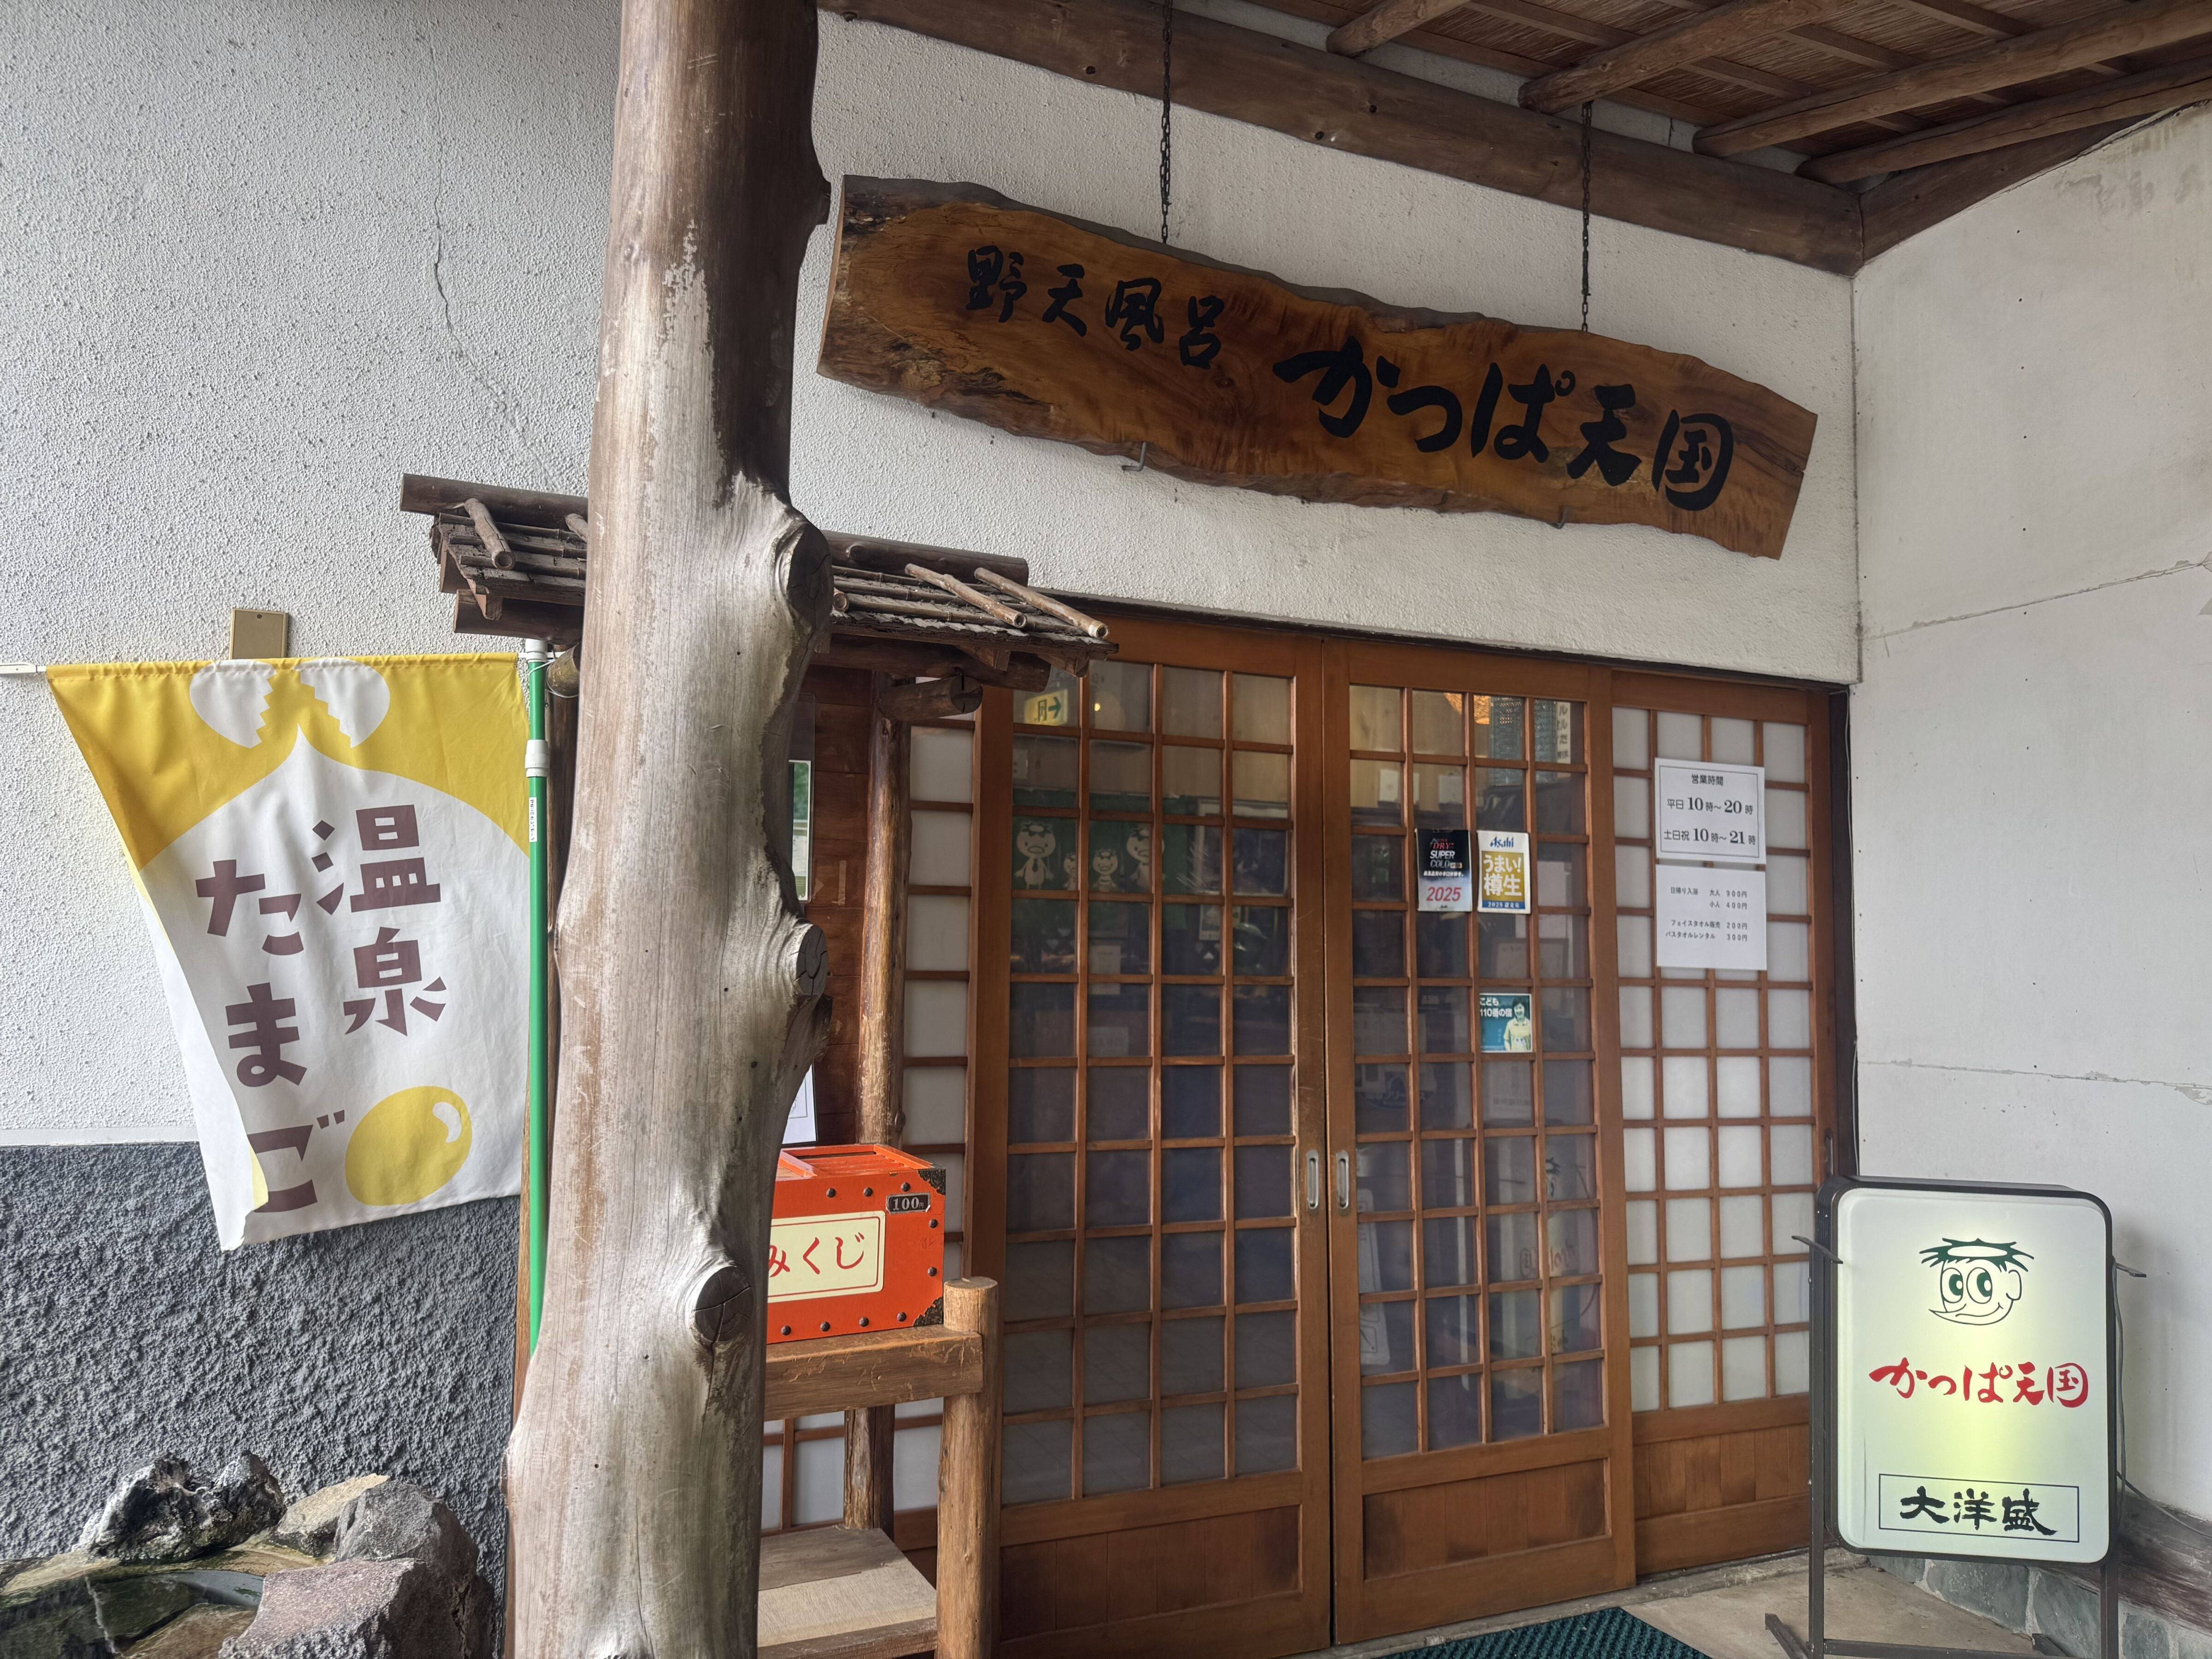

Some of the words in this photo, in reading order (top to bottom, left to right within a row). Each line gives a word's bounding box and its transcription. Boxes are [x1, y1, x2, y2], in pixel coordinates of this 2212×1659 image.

[965, 244, 1224, 370] 野天風呂
[1272, 337, 1734, 512] かっぱ天国
[1691, 774, 1724, 786] 営業時間
[1667, 798, 1684, 809] 平日
[1664, 829, 1690, 841] 土日祝
[1490, 836, 1514, 848] Asahi
[1430, 850, 1455, 859] SUPER
[1430, 859, 1451, 868] COLD
[1483, 854, 1522, 873] うまい!
[1483, 873, 1522, 896] 樽生
[1426, 887, 1462, 902] 2025
[1671, 886, 1698, 895] 日帰り入浴
[1726, 890, 1747, 898] 900円
[1726, 902, 1747, 910] 400円
[311, 804, 447, 1037] 温泉
[1671, 919, 1720, 929] フェイスタオル販売
[1480, 997, 1499, 1006] こども
[195, 859, 345, 1214] たまご
[892, 1196, 924, 1211] 100円
[1869, 1357, 2089, 1408] かっぱ天国
[1899, 1485, 2058, 1536] 大洋盛
